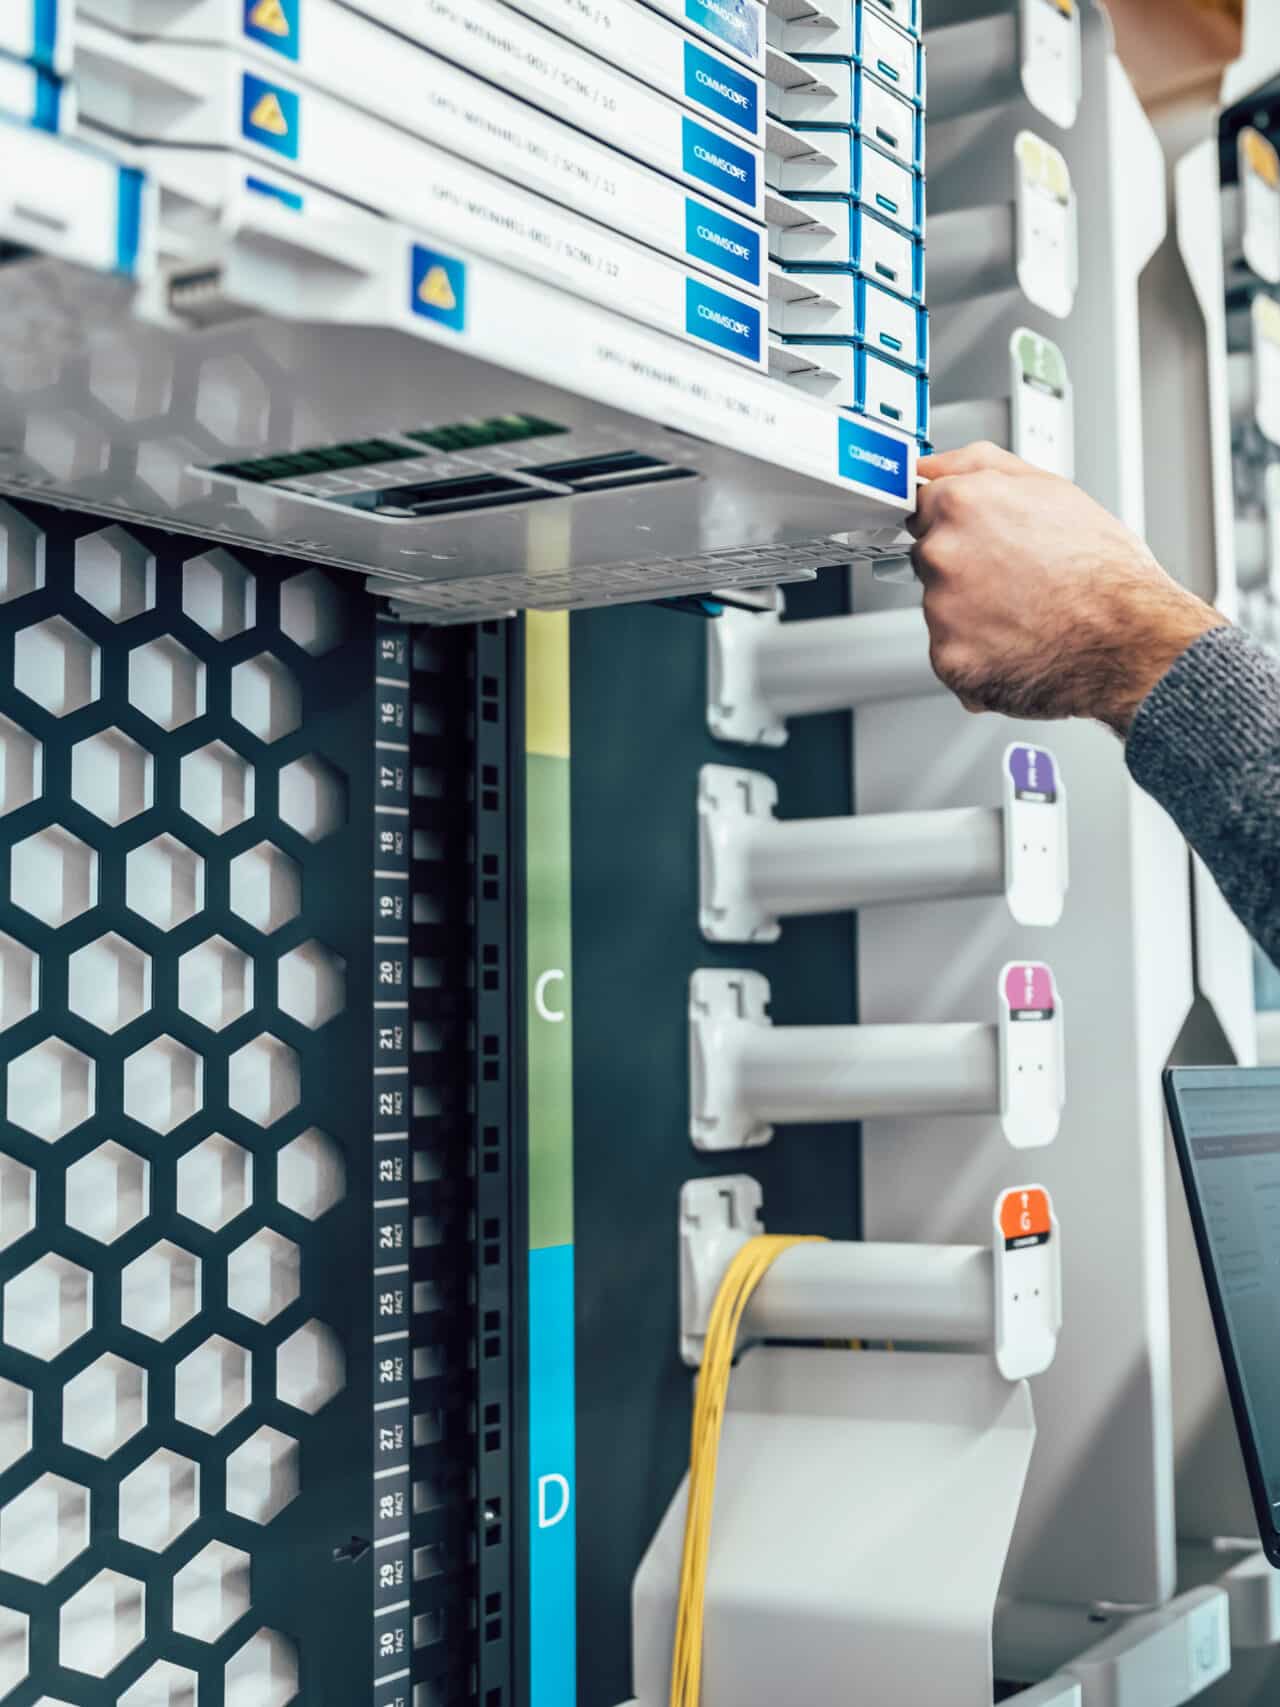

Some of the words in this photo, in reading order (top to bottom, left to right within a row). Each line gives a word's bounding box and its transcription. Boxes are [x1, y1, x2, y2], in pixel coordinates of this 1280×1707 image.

[695, 69, 749, 109] COMMSCOPE
[693, 145, 747, 182] COMMSCOPE
[696, 225, 750, 261] COMMSCOPE
[697, 304, 751, 339] COMMSCOPE
[848, 443, 900, 476] COMMSCOPE
[382, 639, 395, 659] 15
[381, 702, 395, 723] 16
[381, 766, 394, 787] 17
[380, 832, 394, 852] 18
[380, 896, 394, 917] 19
[379, 961, 394, 984] 20
[535, 970, 565, 1022] C
[379, 1029, 393, 1049] 21
[379, 1093, 393, 1115] 22
[379, 1160, 393, 1181] 23
[379, 1226, 393, 1248] 24
[379, 1293, 394, 1315] 25
[379, 1360, 394, 1383] 26
[379, 1428, 394, 1451] 27
[379, 1495, 394, 1519] 28
[538, 1473, 569, 1529] D
[380, 1564, 394, 1588] 29
[380, 1632, 394, 1656] 30
